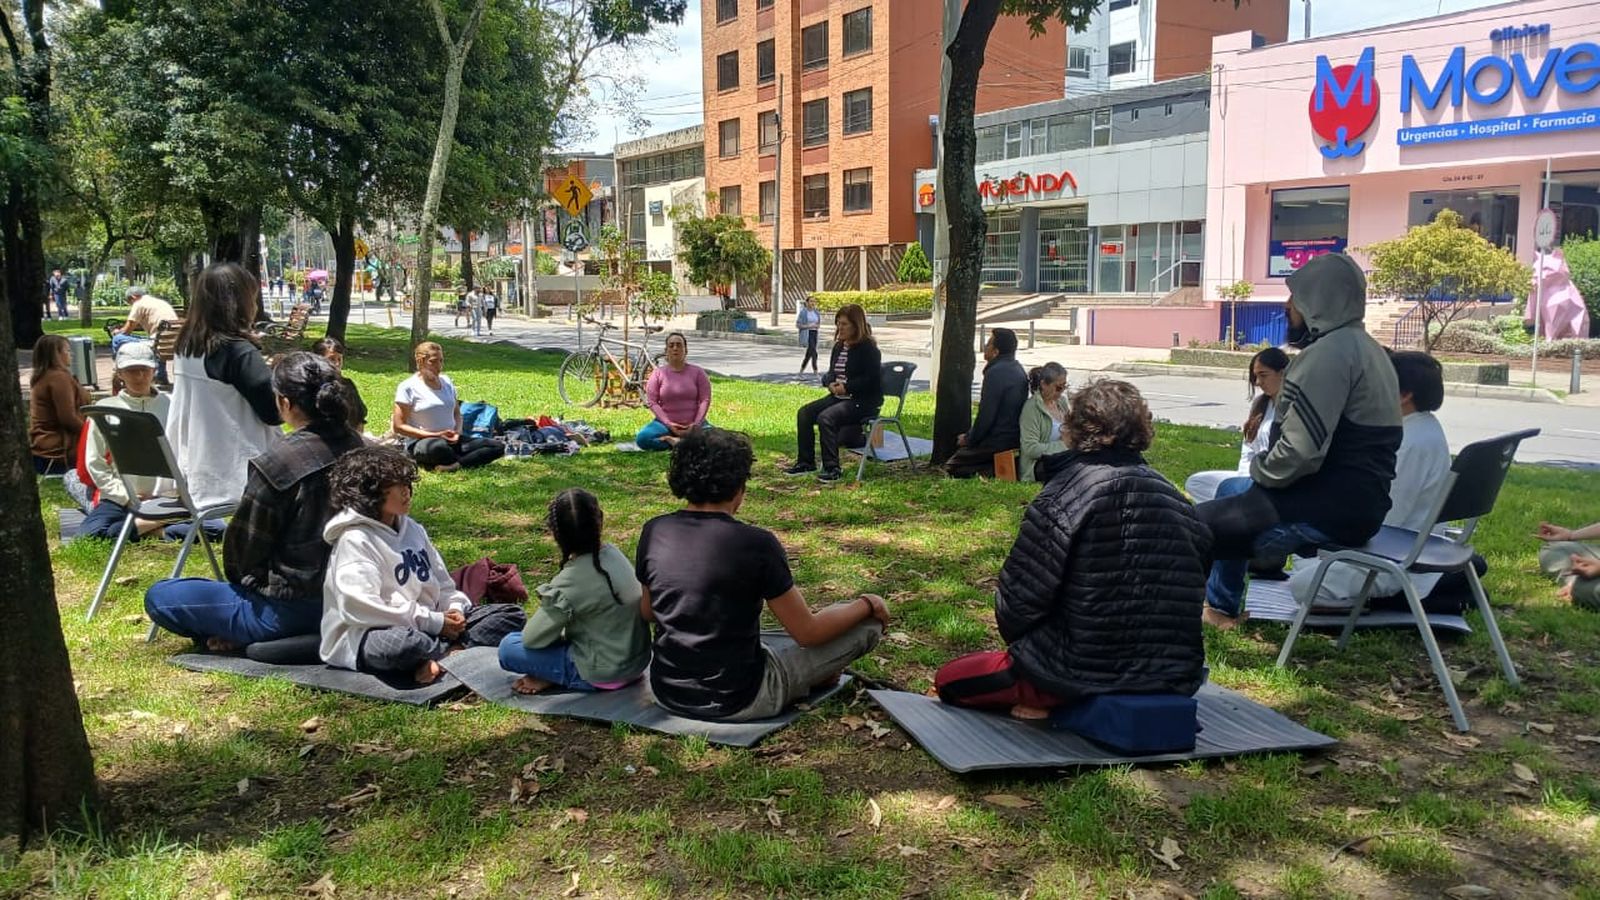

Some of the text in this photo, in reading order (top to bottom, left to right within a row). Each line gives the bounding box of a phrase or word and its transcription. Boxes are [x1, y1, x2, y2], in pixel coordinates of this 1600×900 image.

[1401, 113, 1595, 142] Urgencias Hospital Farmacia
